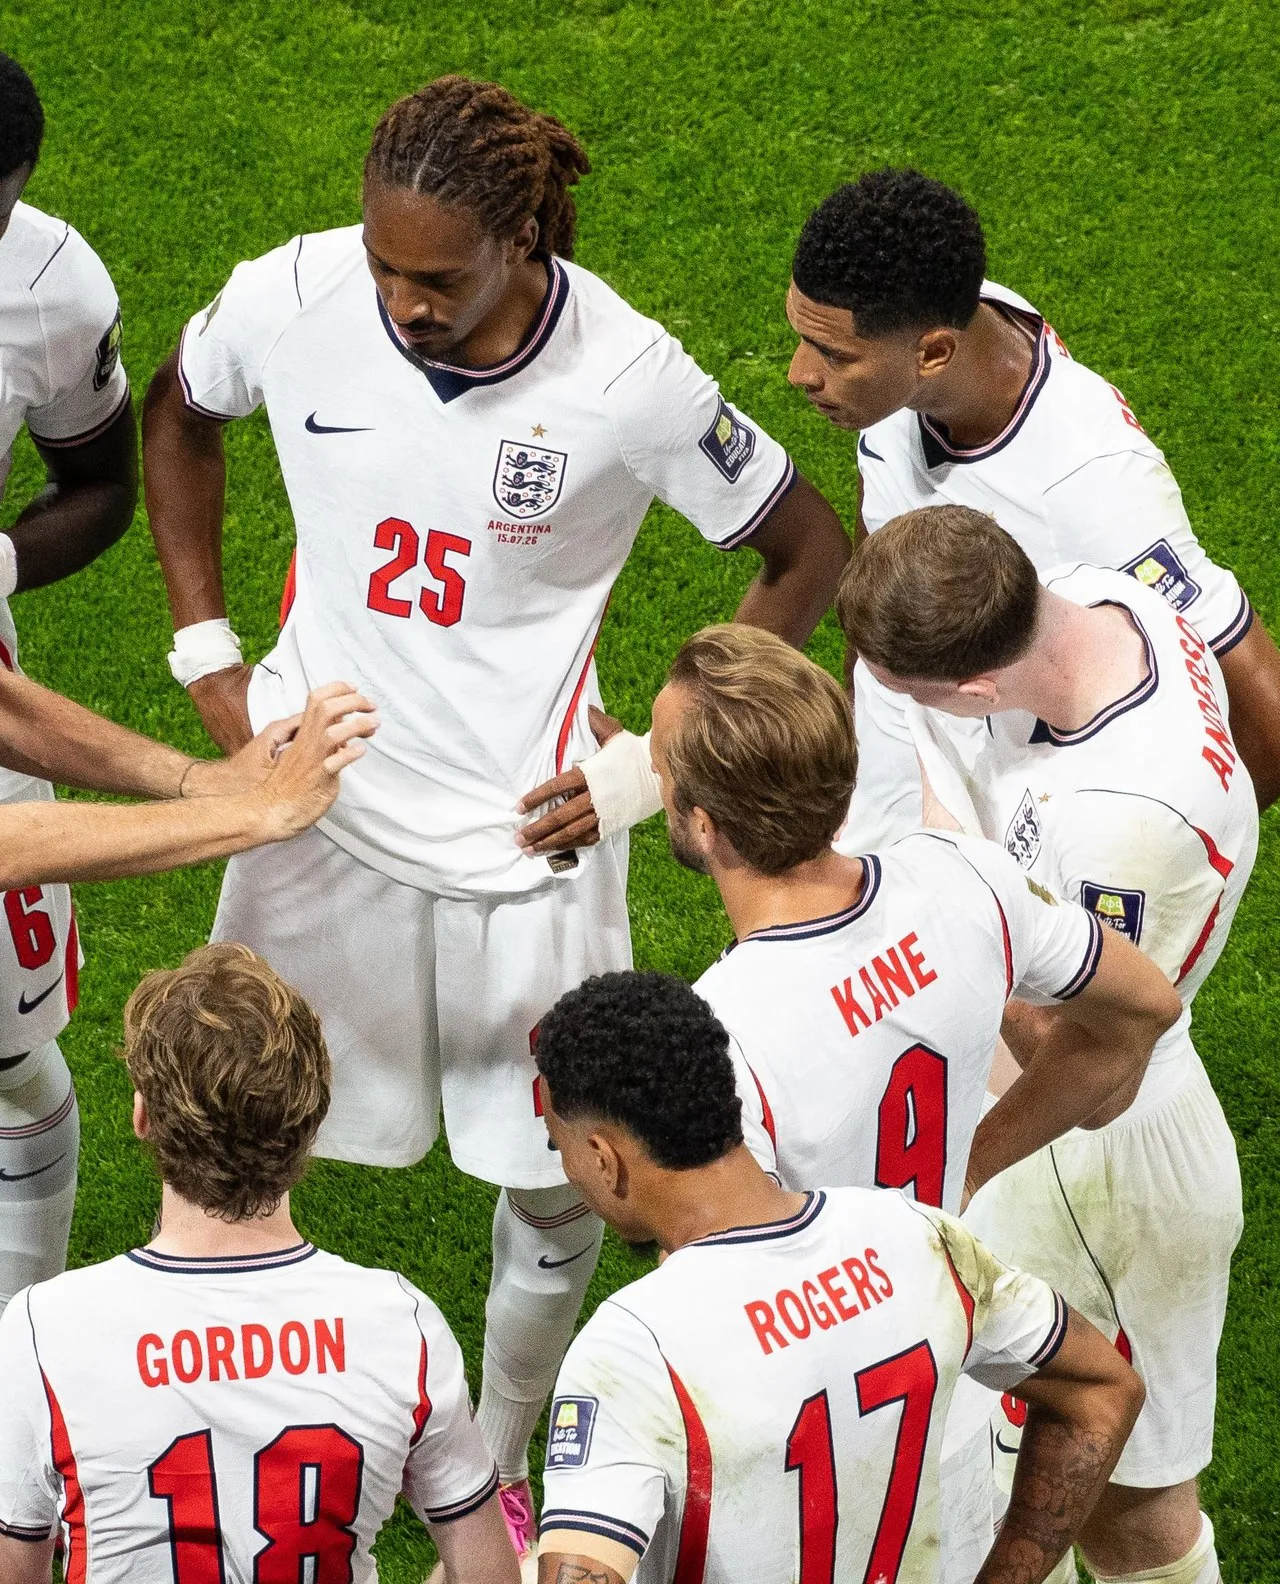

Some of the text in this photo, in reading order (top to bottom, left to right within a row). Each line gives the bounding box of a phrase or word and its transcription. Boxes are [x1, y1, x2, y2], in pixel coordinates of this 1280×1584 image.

[367, 517, 472, 628] 25
[487, 520, 552, 534] ARGENTINA
[497, 533, 538, 545] 15.07.26
[1175, 615, 1236, 794] ANDERSO
[3, 886, 57, 971] 6
[1114, 918, 1126, 930] For
[830, 931, 938, 1037] KANE
[874, 1042, 948, 1210] 9
[136, 1317, 347, 1388] GORDON
[745, 1247, 895, 1355] ROGERS
[146, 1422, 365, 1584] 18
[784, 1338, 939, 1584] 17
